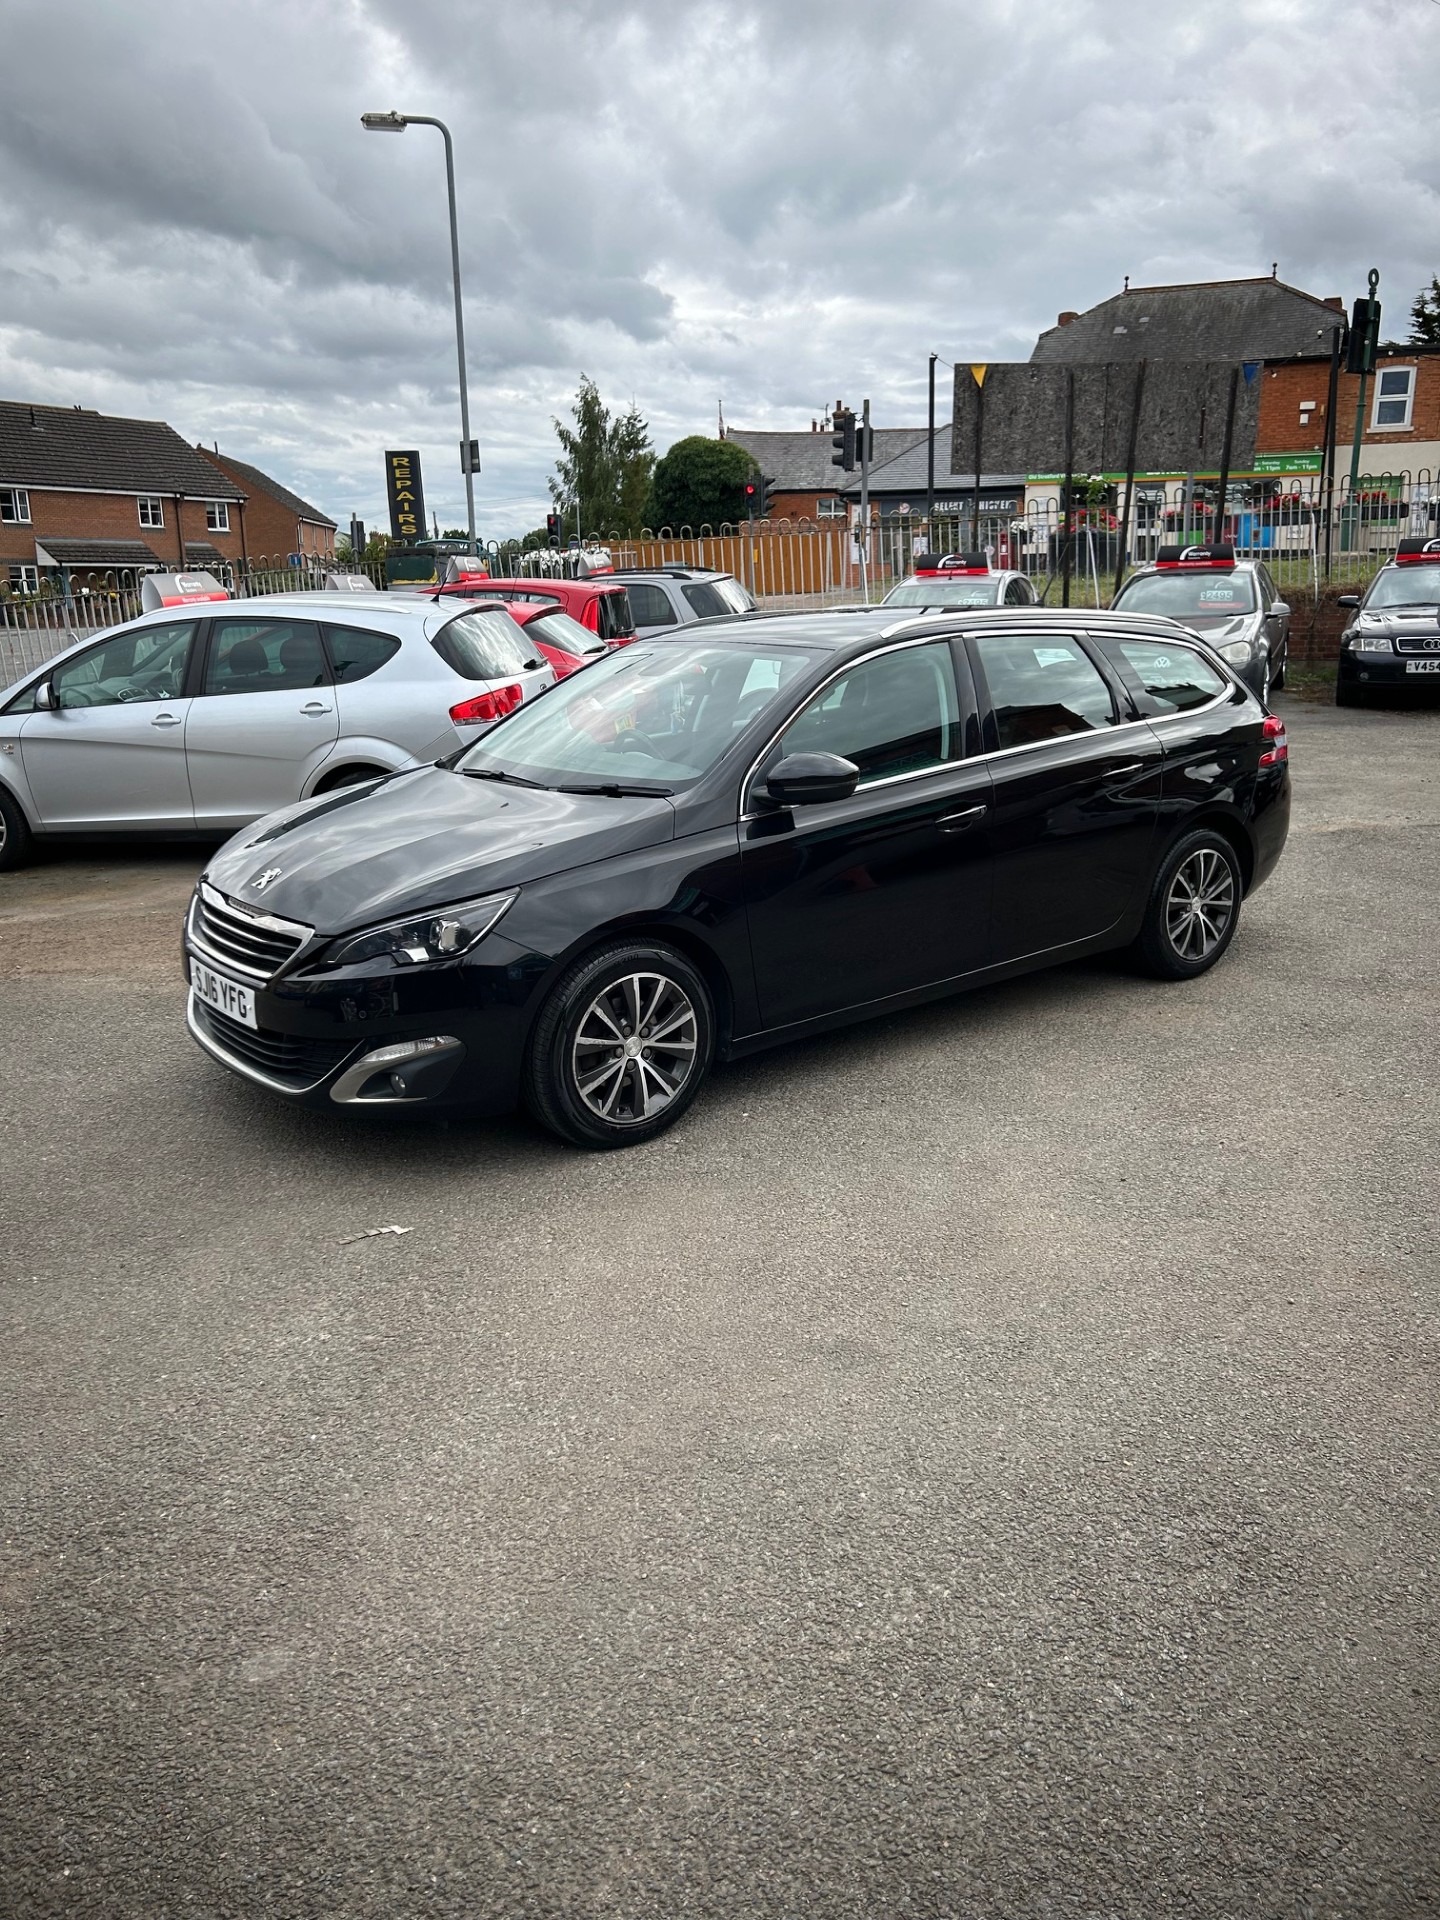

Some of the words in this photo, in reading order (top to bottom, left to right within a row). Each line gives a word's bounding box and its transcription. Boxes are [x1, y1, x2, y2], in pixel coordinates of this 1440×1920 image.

[392, 457, 417, 534] REPAIRS
[196, 966, 218, 1003] SJ16
[220, 981, 247, 1018] YFG
